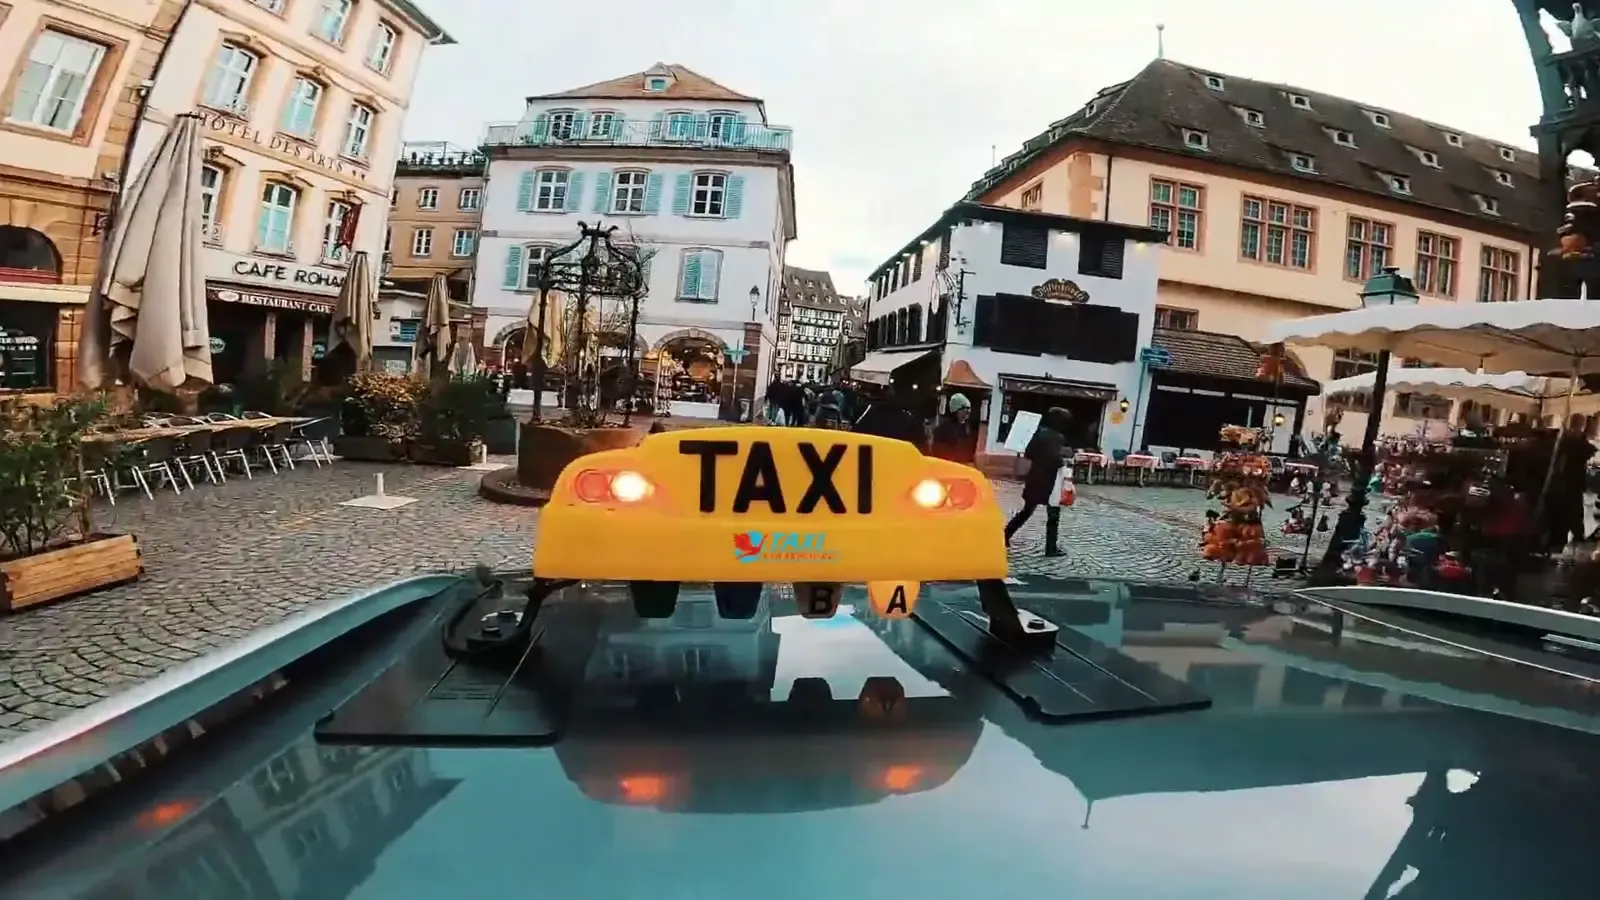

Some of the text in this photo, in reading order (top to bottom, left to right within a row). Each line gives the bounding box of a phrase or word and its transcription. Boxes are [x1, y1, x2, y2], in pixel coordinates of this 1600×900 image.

[269, 136, 301, 156] DES
[306, 151, 343, 172] ARTS
[241, 294, 306, 311] RESTAURANT
[679, 440, 873, 514] TAXI
[770, 531, 828, 551] TAXI
[809, 585, 835, 614] B
[886, 585, 908, 614] A
